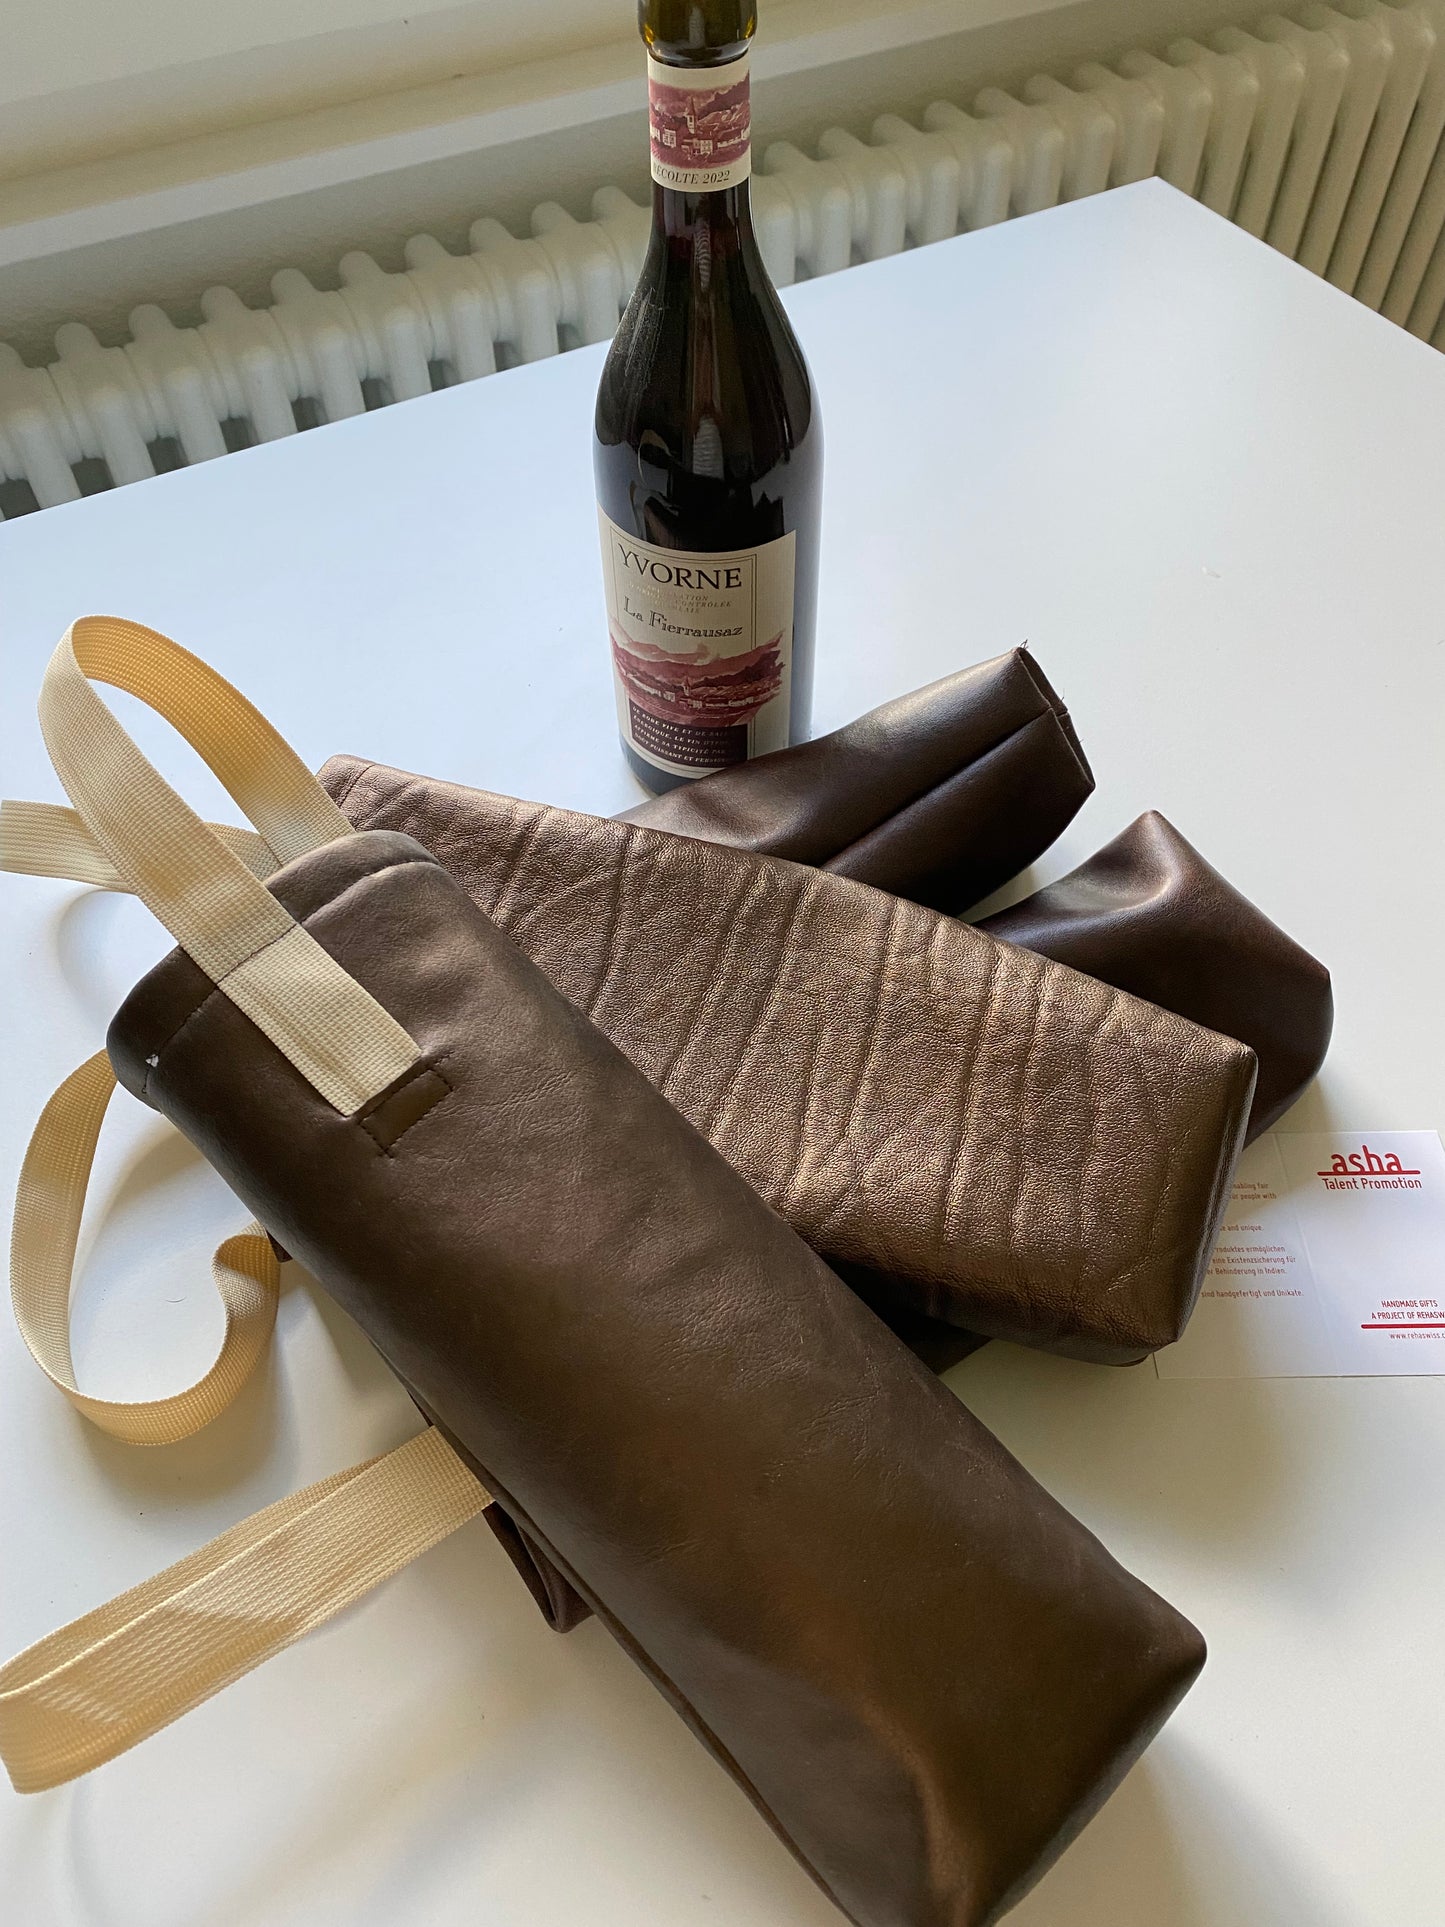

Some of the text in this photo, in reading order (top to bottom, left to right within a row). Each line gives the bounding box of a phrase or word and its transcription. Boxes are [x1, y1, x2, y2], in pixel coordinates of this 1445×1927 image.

[702, 170, 730, 184] 2022
[617, 542, 742, 590] YVORNE
[624, 595, 644, 622] La
[649, 610, 743, 638] Fierrausaz
[1331, 1144, 1404, 1173] asha
[1322, 1177, 1422, 1190] Talent Promotion
[1227, 1256, 1285, 1264] Existenzsicherung
[1215, 1267, 1256, 1276] Behinderung
[1216, 1290, 1262, 1299] handgefertigt
[1381, 1300, 1438, 1308] HANDMADE GIFTS
[1371, 1312, 1377, 1320] A
[1377, 1312, 1406, 1320] PROJECT
